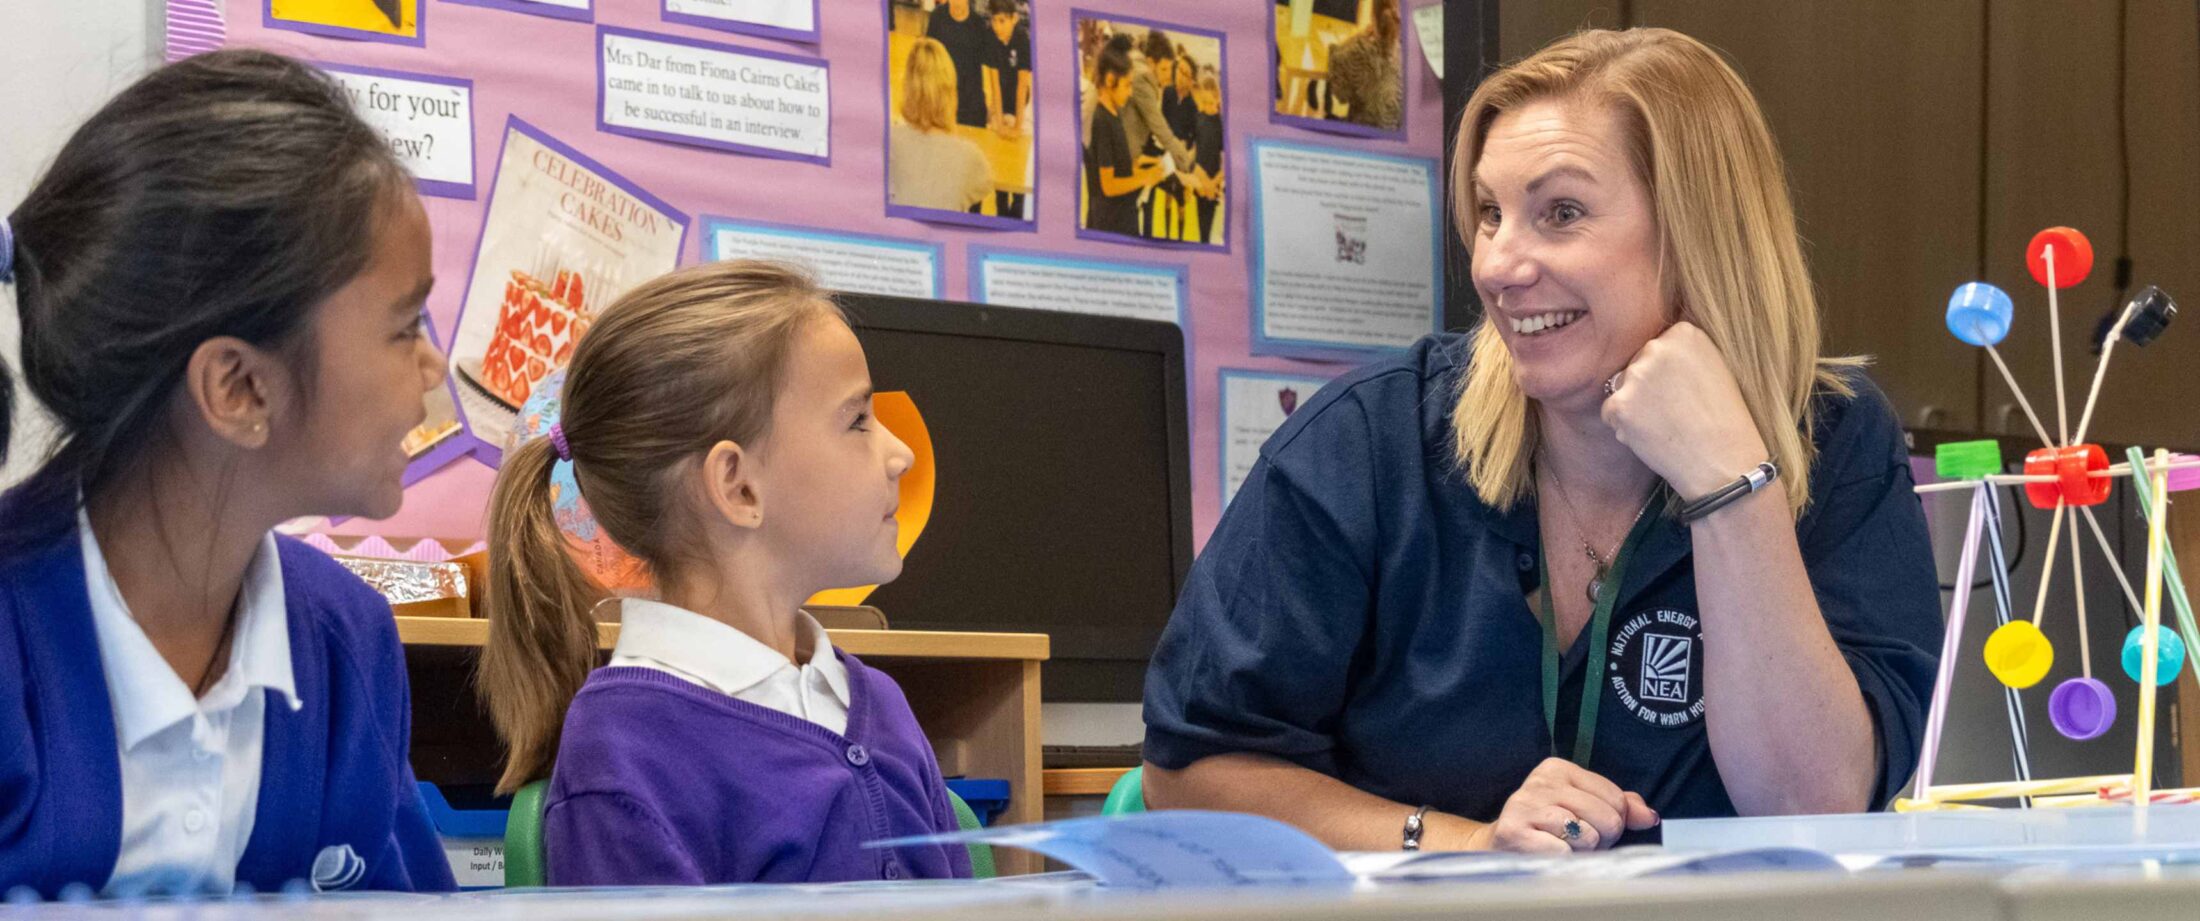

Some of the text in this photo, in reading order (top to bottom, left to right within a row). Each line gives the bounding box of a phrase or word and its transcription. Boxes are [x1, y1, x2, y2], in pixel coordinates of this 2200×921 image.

[607, 48, 820, 94] Mrs Dar from Fiona Cairns Cakes
[369, 82, 401, 112] for
[407, 94, 460, 120] your
[608, 77, 820, 118] came in to talk to us about how to
[624, 101, 804, 139] be successful in an interview.
[533, 149, 660, 235] CELEBRATION
[560, 192, 623, 241] CAKES
[1611, 609, 1698, 657] NATIONAL ENERGY
[1611, 675, 1639, 711] ACTION
[1637, 706, 1657, 723] FOR
[1660, 711, 1689, 726] WARM
[1644, 679, 1683, 698] NEA
[470, 861, 490, 872] Input
[498, 860, 505, 870] B
[474, 847, 504, 857] Daily W
